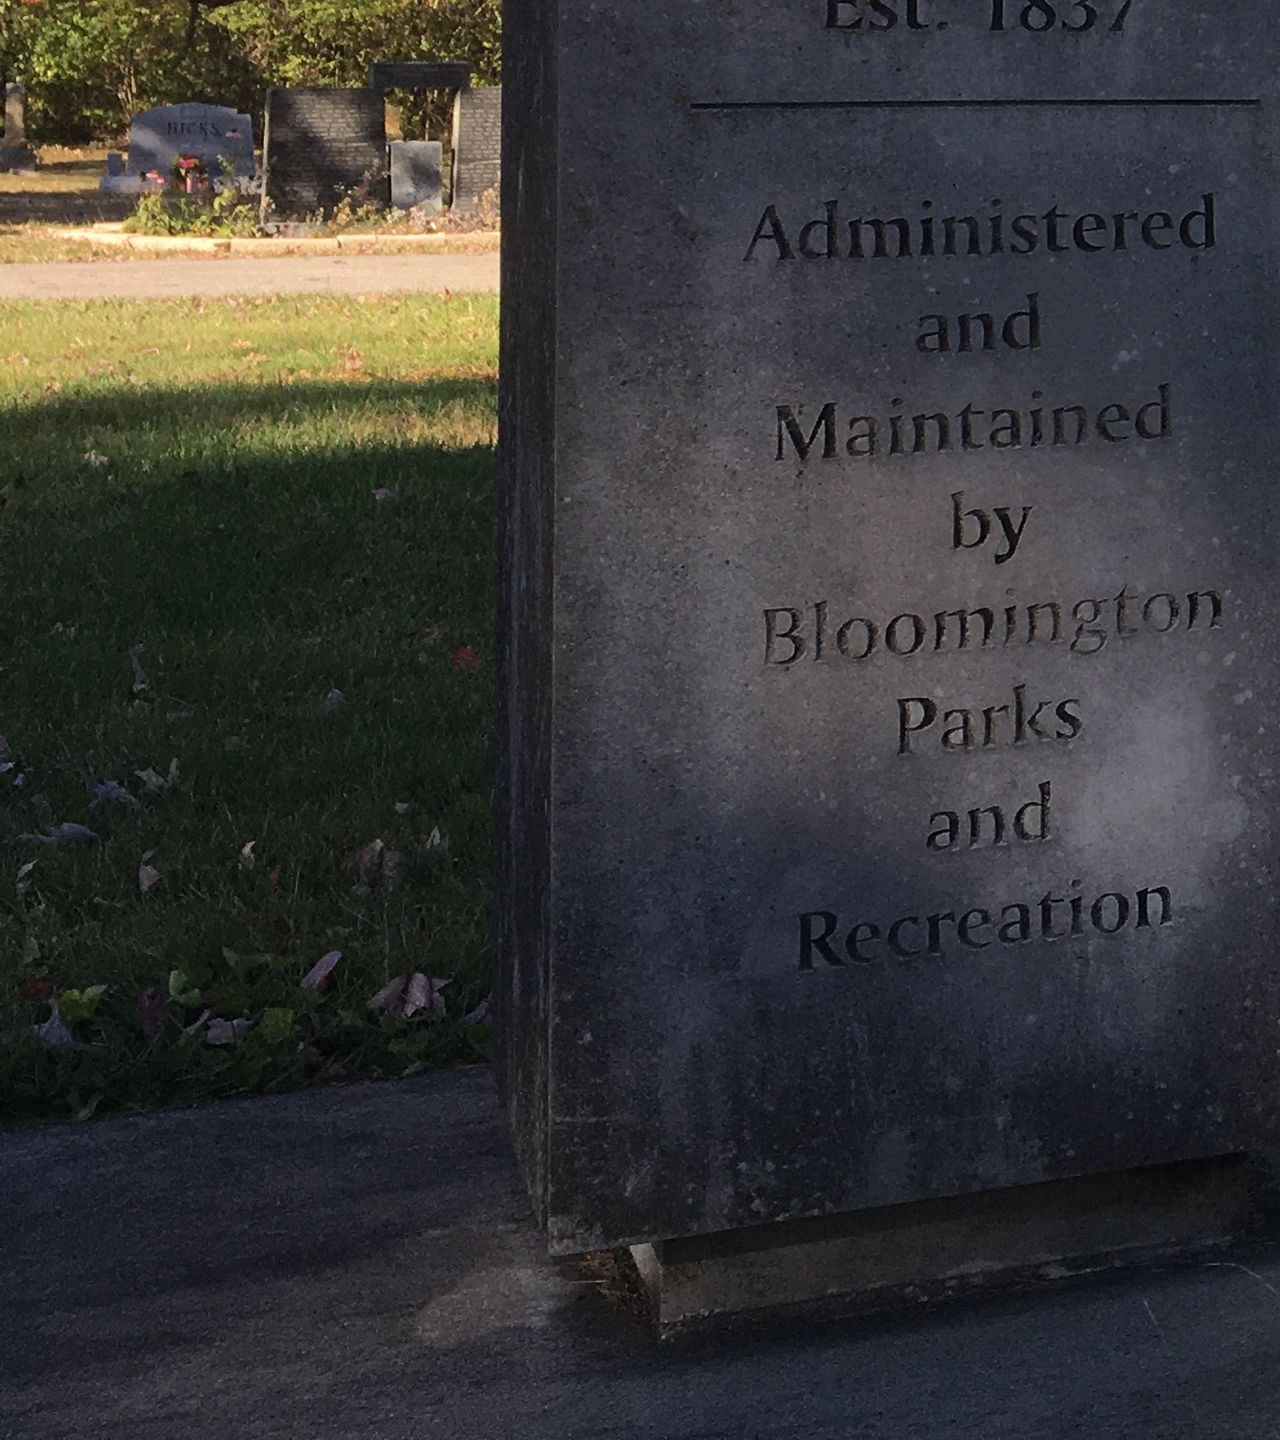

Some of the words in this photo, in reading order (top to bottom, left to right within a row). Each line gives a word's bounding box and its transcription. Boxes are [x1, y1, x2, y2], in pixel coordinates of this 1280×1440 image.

[167, 121, 222, 141] HICKS
[744, 194, 1217, 261] Administered
[916, 292, 1042, 353] and
[776, 382, 1173, 463] Maintained
[951, 490, 1033, 564] by
[763, 585, 1224, 666] Bloomington
[896, 684, 1083, 755] Parks
[926, 781, 1053, 852] and
[801, 879, 1174, 970] Recreation
